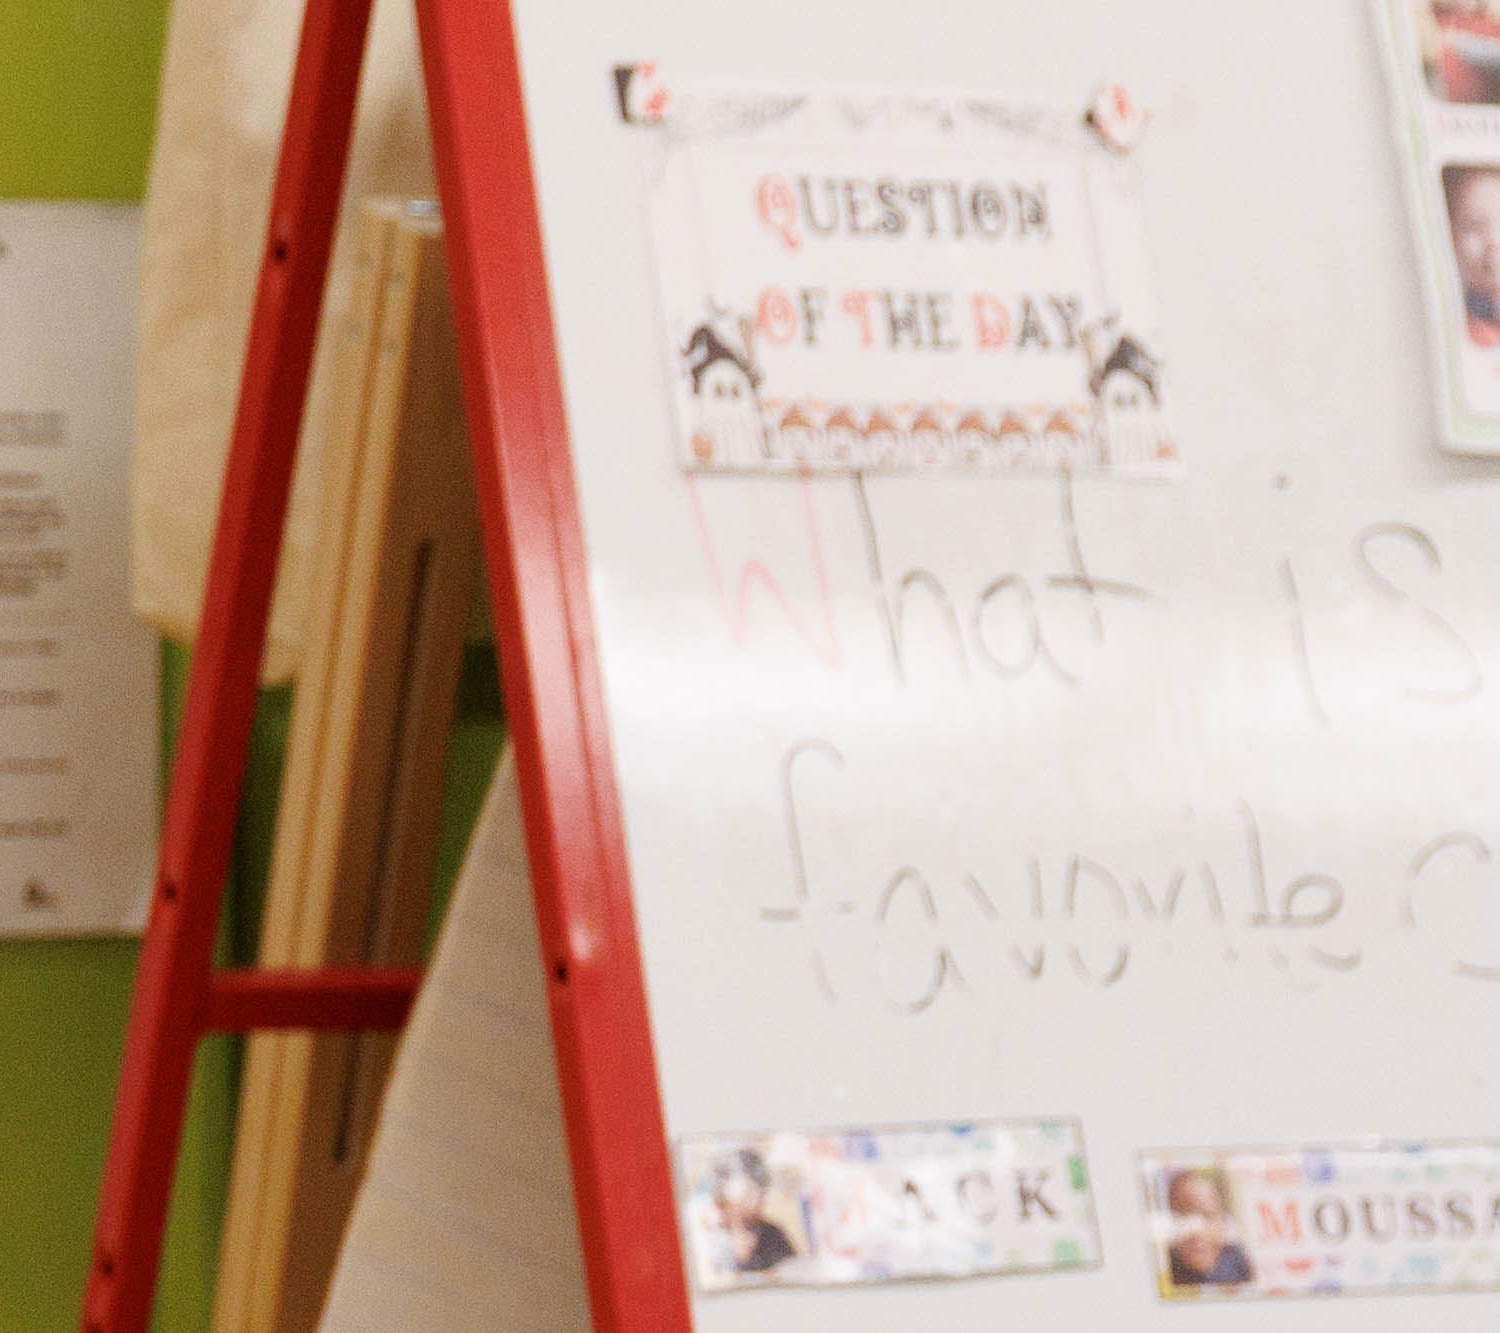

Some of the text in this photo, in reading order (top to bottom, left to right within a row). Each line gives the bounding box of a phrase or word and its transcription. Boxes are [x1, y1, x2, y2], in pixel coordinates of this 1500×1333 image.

[755, 173, 1054, 251] QUESTION
[756, 284, 1083, 351] OF THE DAY
[682, 466, 1152, 686] What
[1273, 472, 1484, 730] is
[840, 1165, 1060, 1230] ACK
